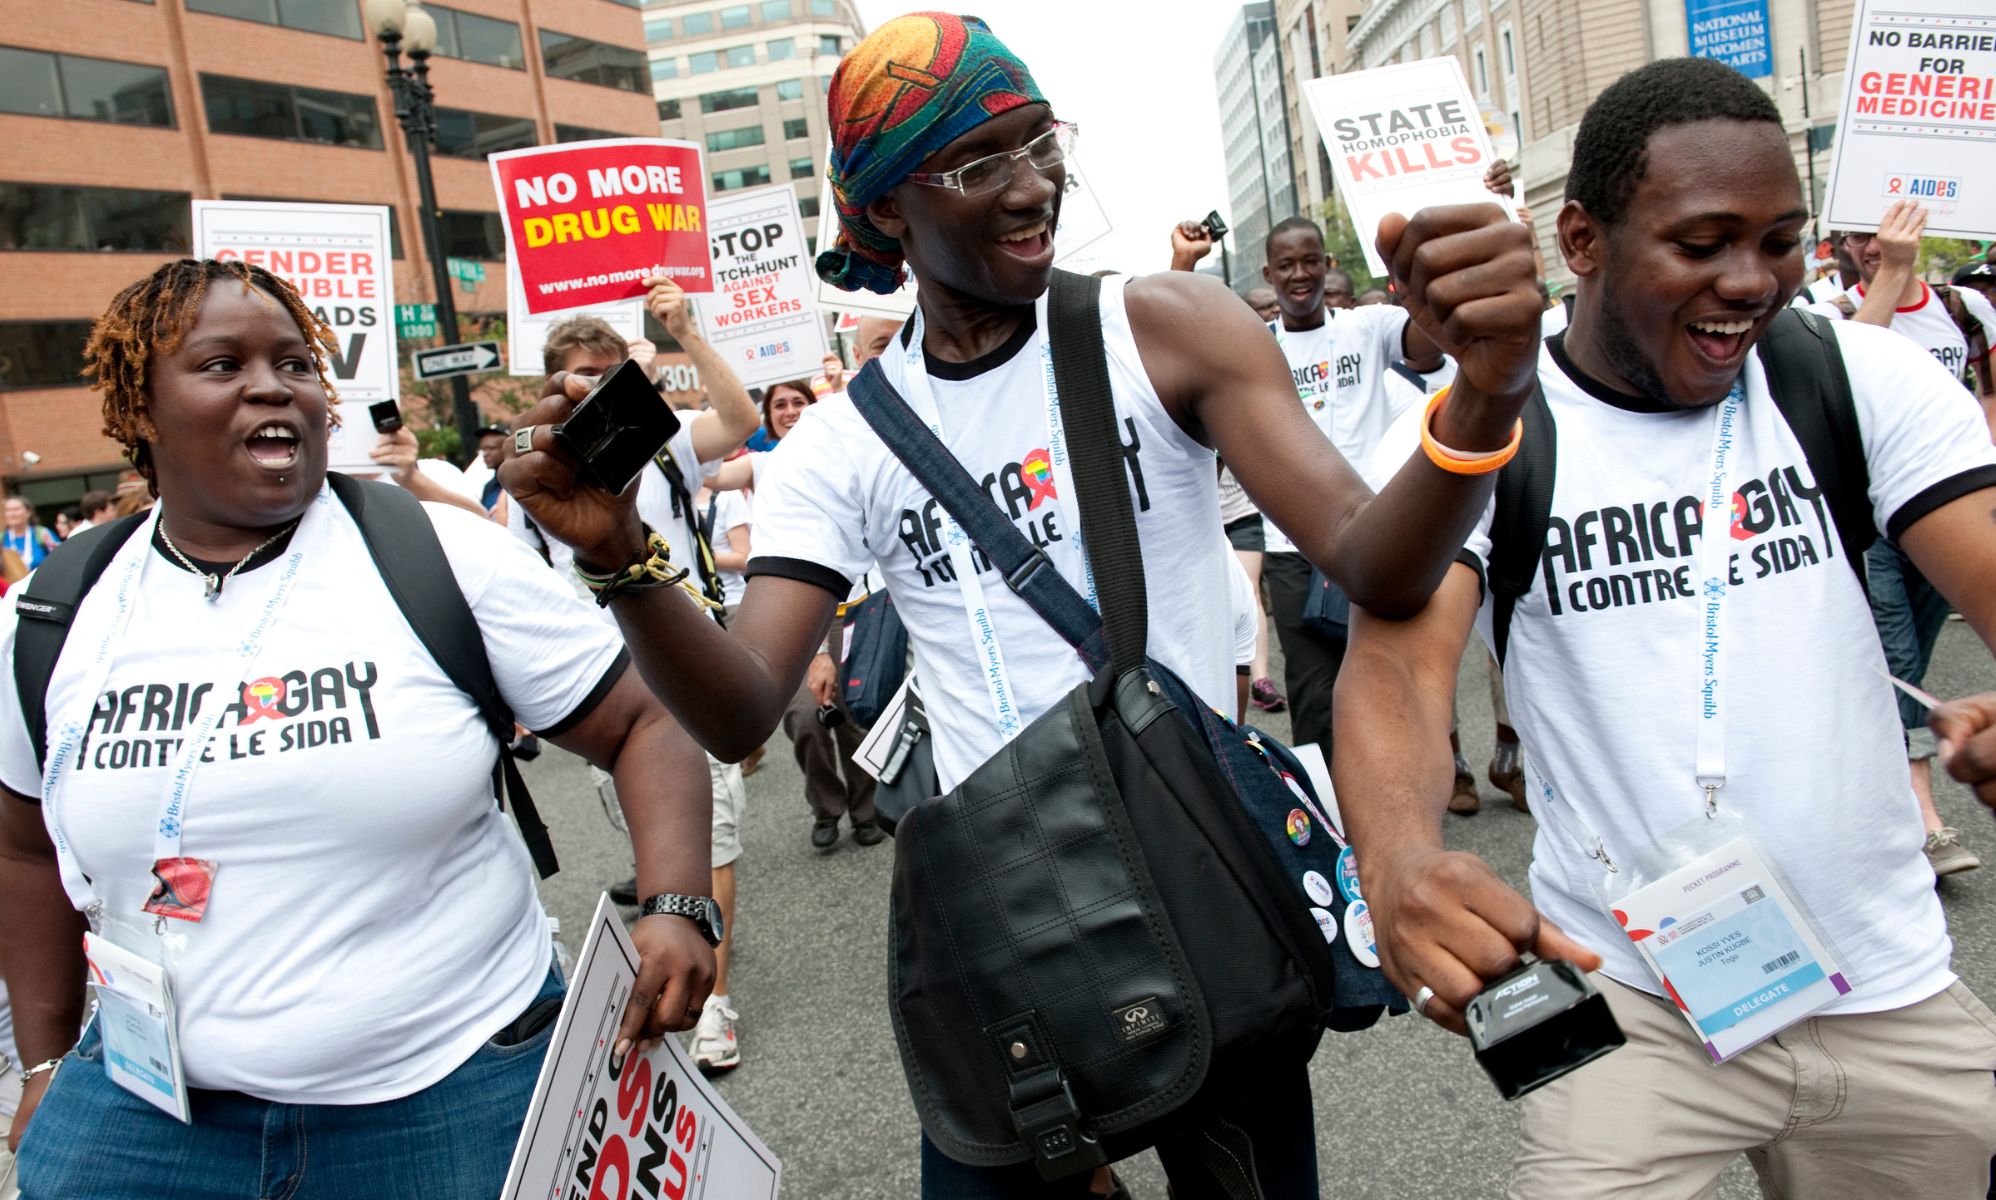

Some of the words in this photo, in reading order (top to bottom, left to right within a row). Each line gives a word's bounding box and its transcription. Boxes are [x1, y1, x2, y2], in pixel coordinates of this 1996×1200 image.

[1693, 10, 1764, 35] NATIONAL
[1694, 23, 1764, 48] MUSEUM
[1709, 36, 1766, 57] WOMEN
[1869, 31, 1901, 47] NO
[1908, 33, 1996, 51] BARRIE
[1731, 50, 1767, 66] ARTS
[1919, 57, 1965, 74] FOR
[1860, 71, 1994, 100] GENERI
[1333, 100, 1466, 141] STATE
[1856, 96, 1996, 120] MEDICINE
[1342, 124, 1471, 154] HOMOPHOBIA
[1346, 136, 1481, 182] KILLS
[514, 173, 577, 208] NO
[587, 165, 684, 198] MORE
[523, 205, 641, 248] DRUG
[647, 203, 701, 232] WAR
[734, 253, 757, 265] THE
[290, 278, 375, 298] UBLE
[539, 264, 705, 294] www.nomoredrugwar.org
[723, 272, 781, 293] AGAINST
[733, 286, 778, 308] SEX
[401, 305, 415, 322] H
[715, 299, 802, 328] WORKERS
[1710, 472, 1726, 509] Squibb
[1739, 465, 1834, 559] GAY
[1569, 565, 1695, 613] CONTRE
[1751, 534, 1820, 579] SIDA
[975, 608, 993, 645] Squibb
[277, 661, 380, 740] GAY
[1701, 679, 1718, 719] Squibb
[95, 737, 215, 769] CONTE
[230, 730, 266, 760] LE
[280, 717, 352, 752] SIDA
[1720, 930, 1743, 946] YVES
[1721, 954, 1740, 966] Togo
[1495, 973, 1539, 1000] ACTION
[1734, 983, 1790, 1017] DELEGATE
